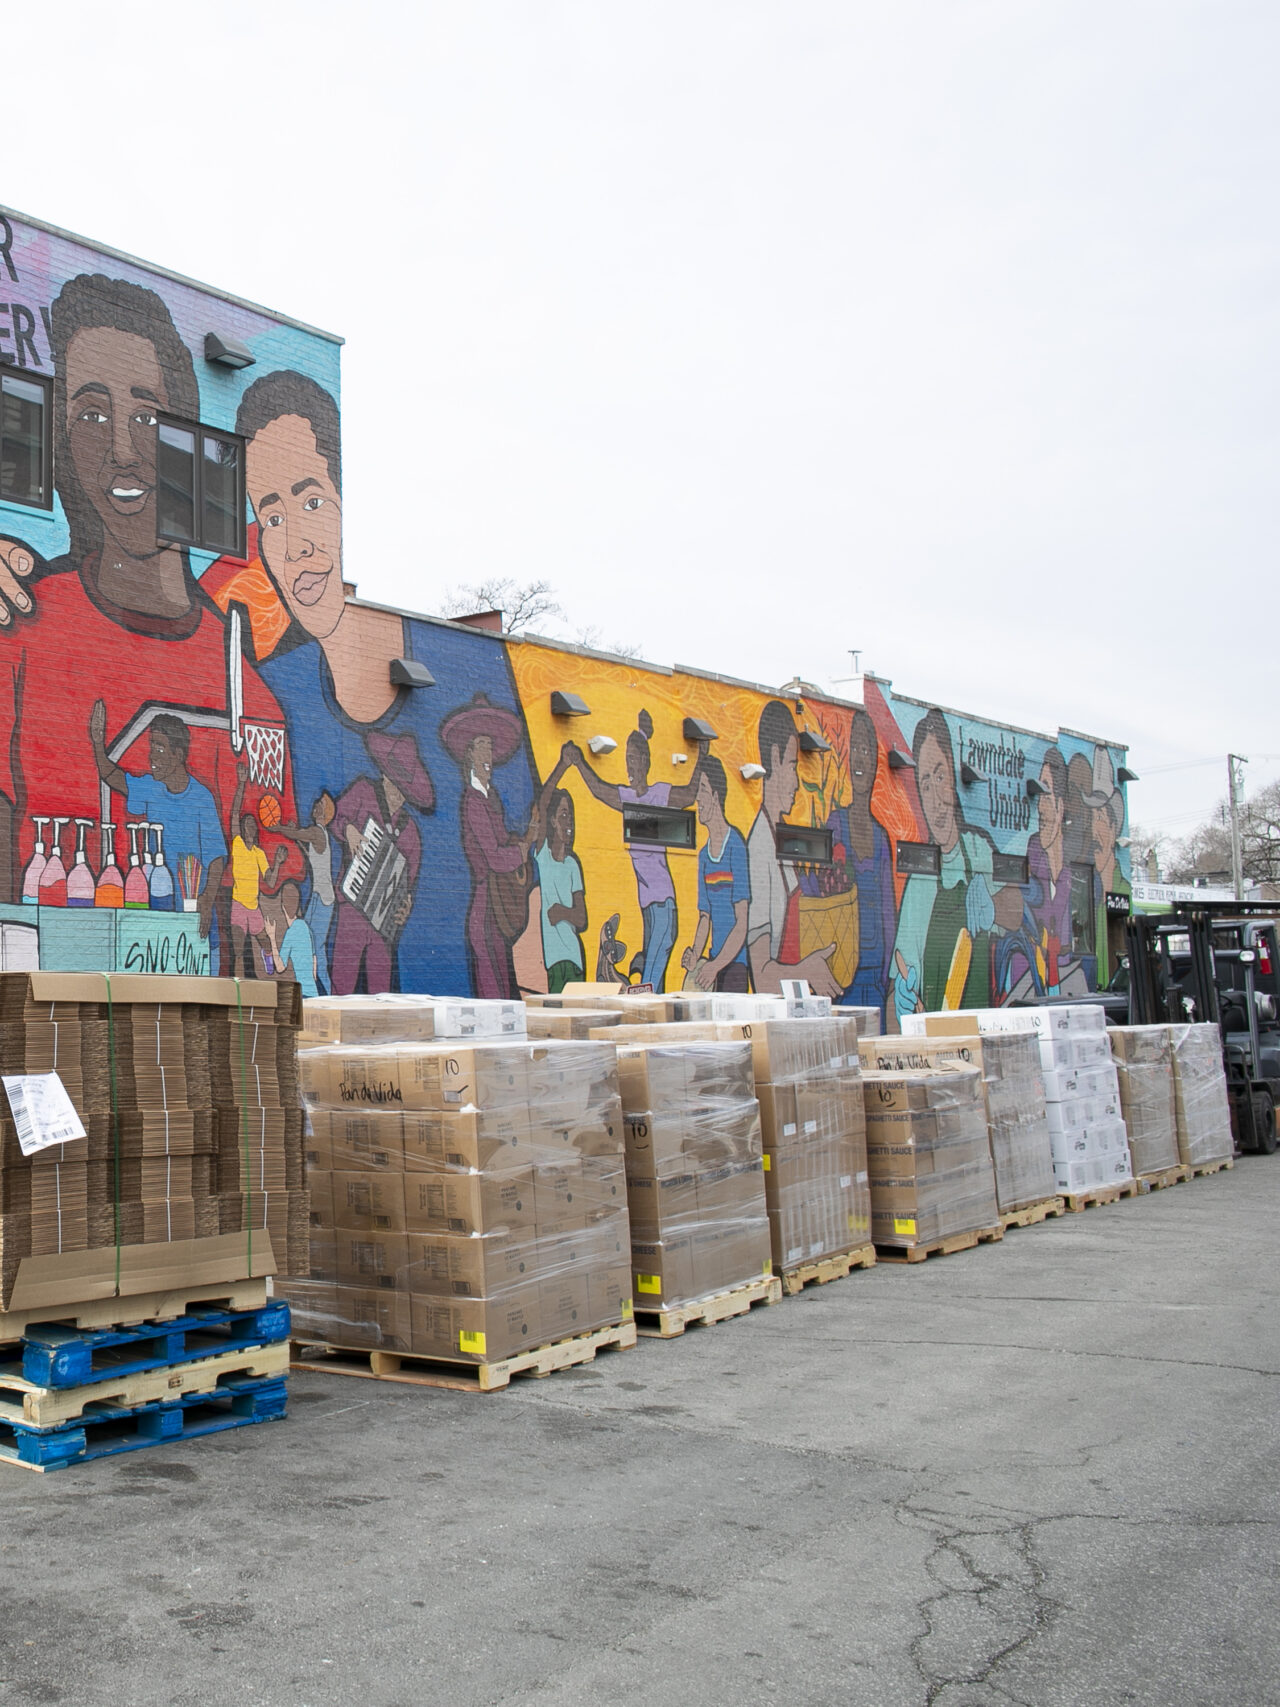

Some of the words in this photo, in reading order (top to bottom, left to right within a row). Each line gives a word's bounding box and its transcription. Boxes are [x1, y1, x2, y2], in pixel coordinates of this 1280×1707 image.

[958, 725, 1026, 779] Lawndale
[988, 777, 1031, 832] Unido
[741, 1024, 753, 1039] 10
[445, 1059, 459, 1075] 10
[339, 1082, 359, 1102] Pan
[372, 1081, 403, 1104] Vida
[883, 1082, 904, 1090] SAUCE
[891, 1147, 912, 1155] SAUCE
